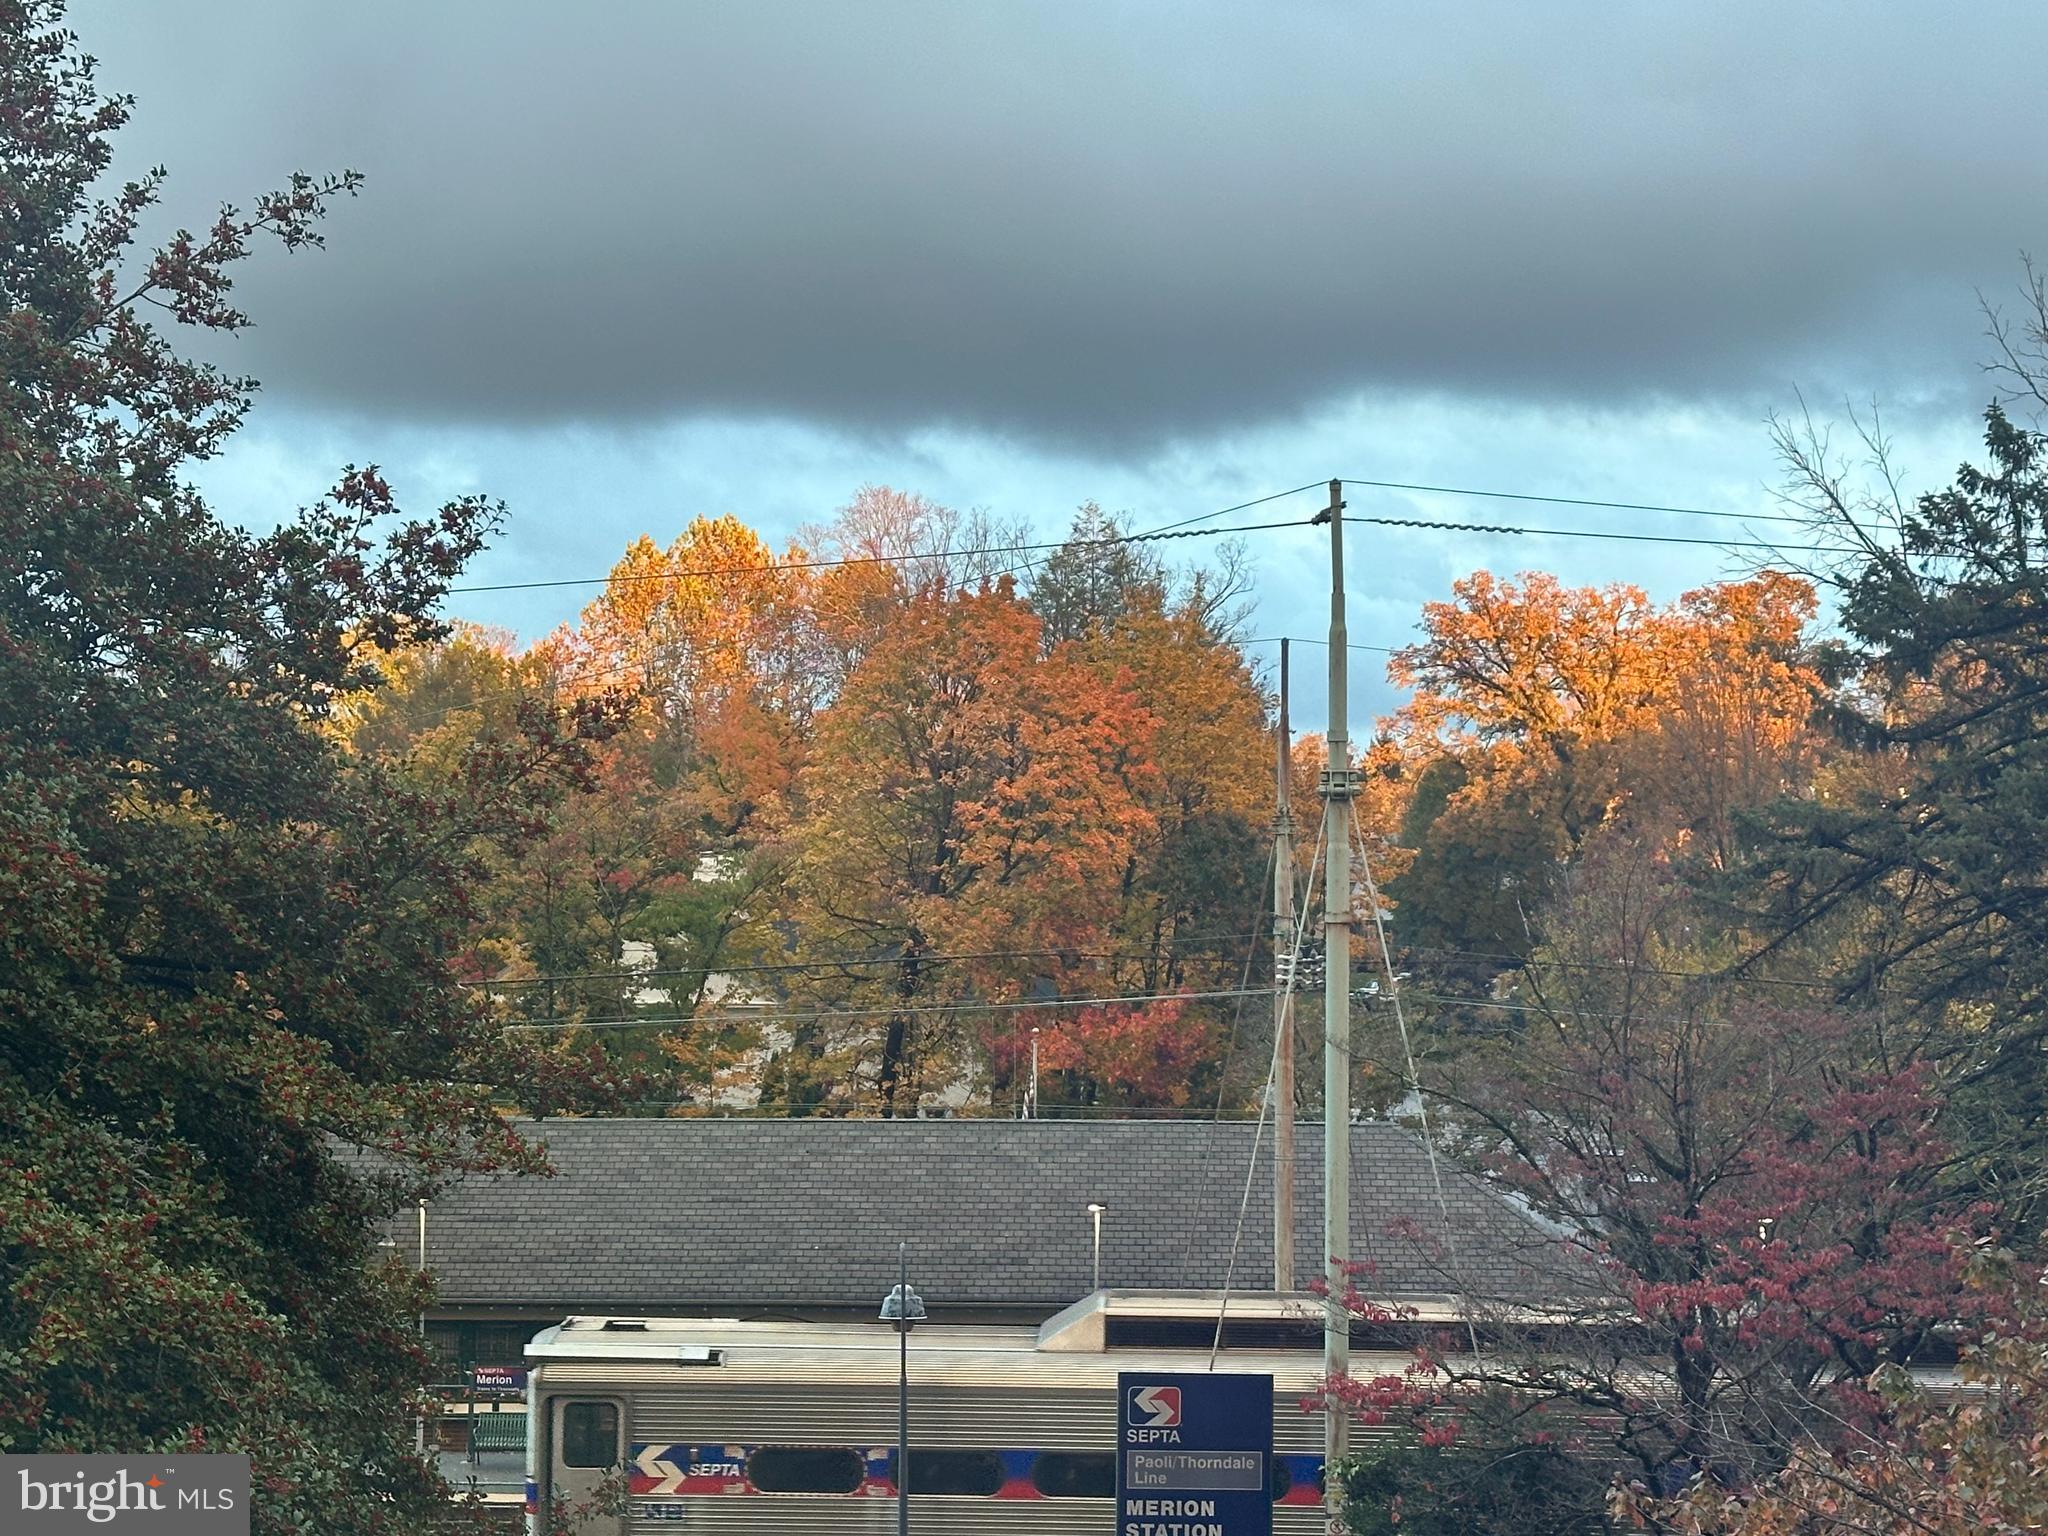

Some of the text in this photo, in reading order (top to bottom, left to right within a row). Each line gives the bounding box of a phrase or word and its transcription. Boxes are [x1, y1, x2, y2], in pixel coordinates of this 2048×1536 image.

[476, 1374, 513, 1385] Merion
[1126, 1429, 1181, 1443] SEPTA
[1134, 1455, 1255, 1469] Paoli/Thorndale
[689, 1463, 740, 1477] SEPTA
[1134, 1471, 1168, 1484] Line
[1126, 1500, 1215, 1517] MERION
[1125, 1522, 1223, 1536] STATION
